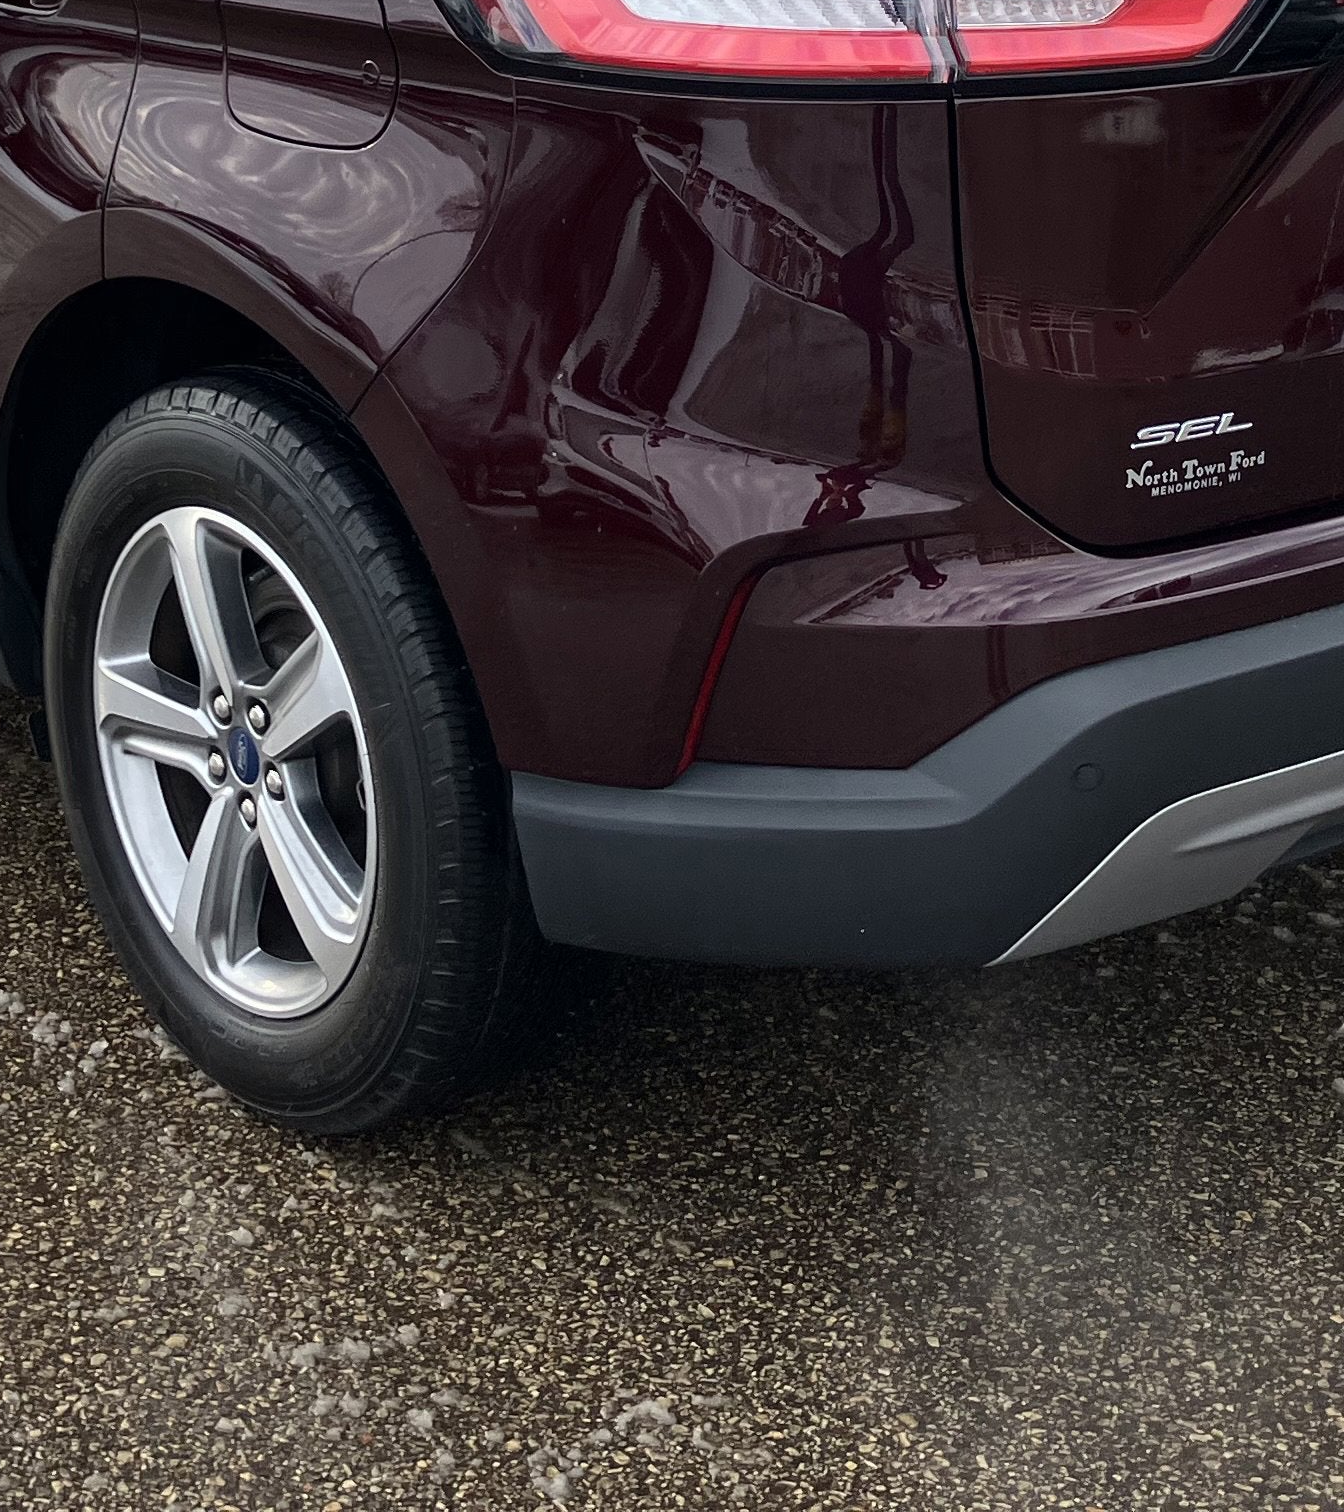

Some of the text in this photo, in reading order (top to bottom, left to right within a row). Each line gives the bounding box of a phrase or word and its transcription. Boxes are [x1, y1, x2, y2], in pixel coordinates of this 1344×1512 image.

[1130, 412, 1254, 450] SEL
[1125, 450, 1266, 489] North Town Ford
[1151, 472, 1242, 497] MENOMONIE, WI
